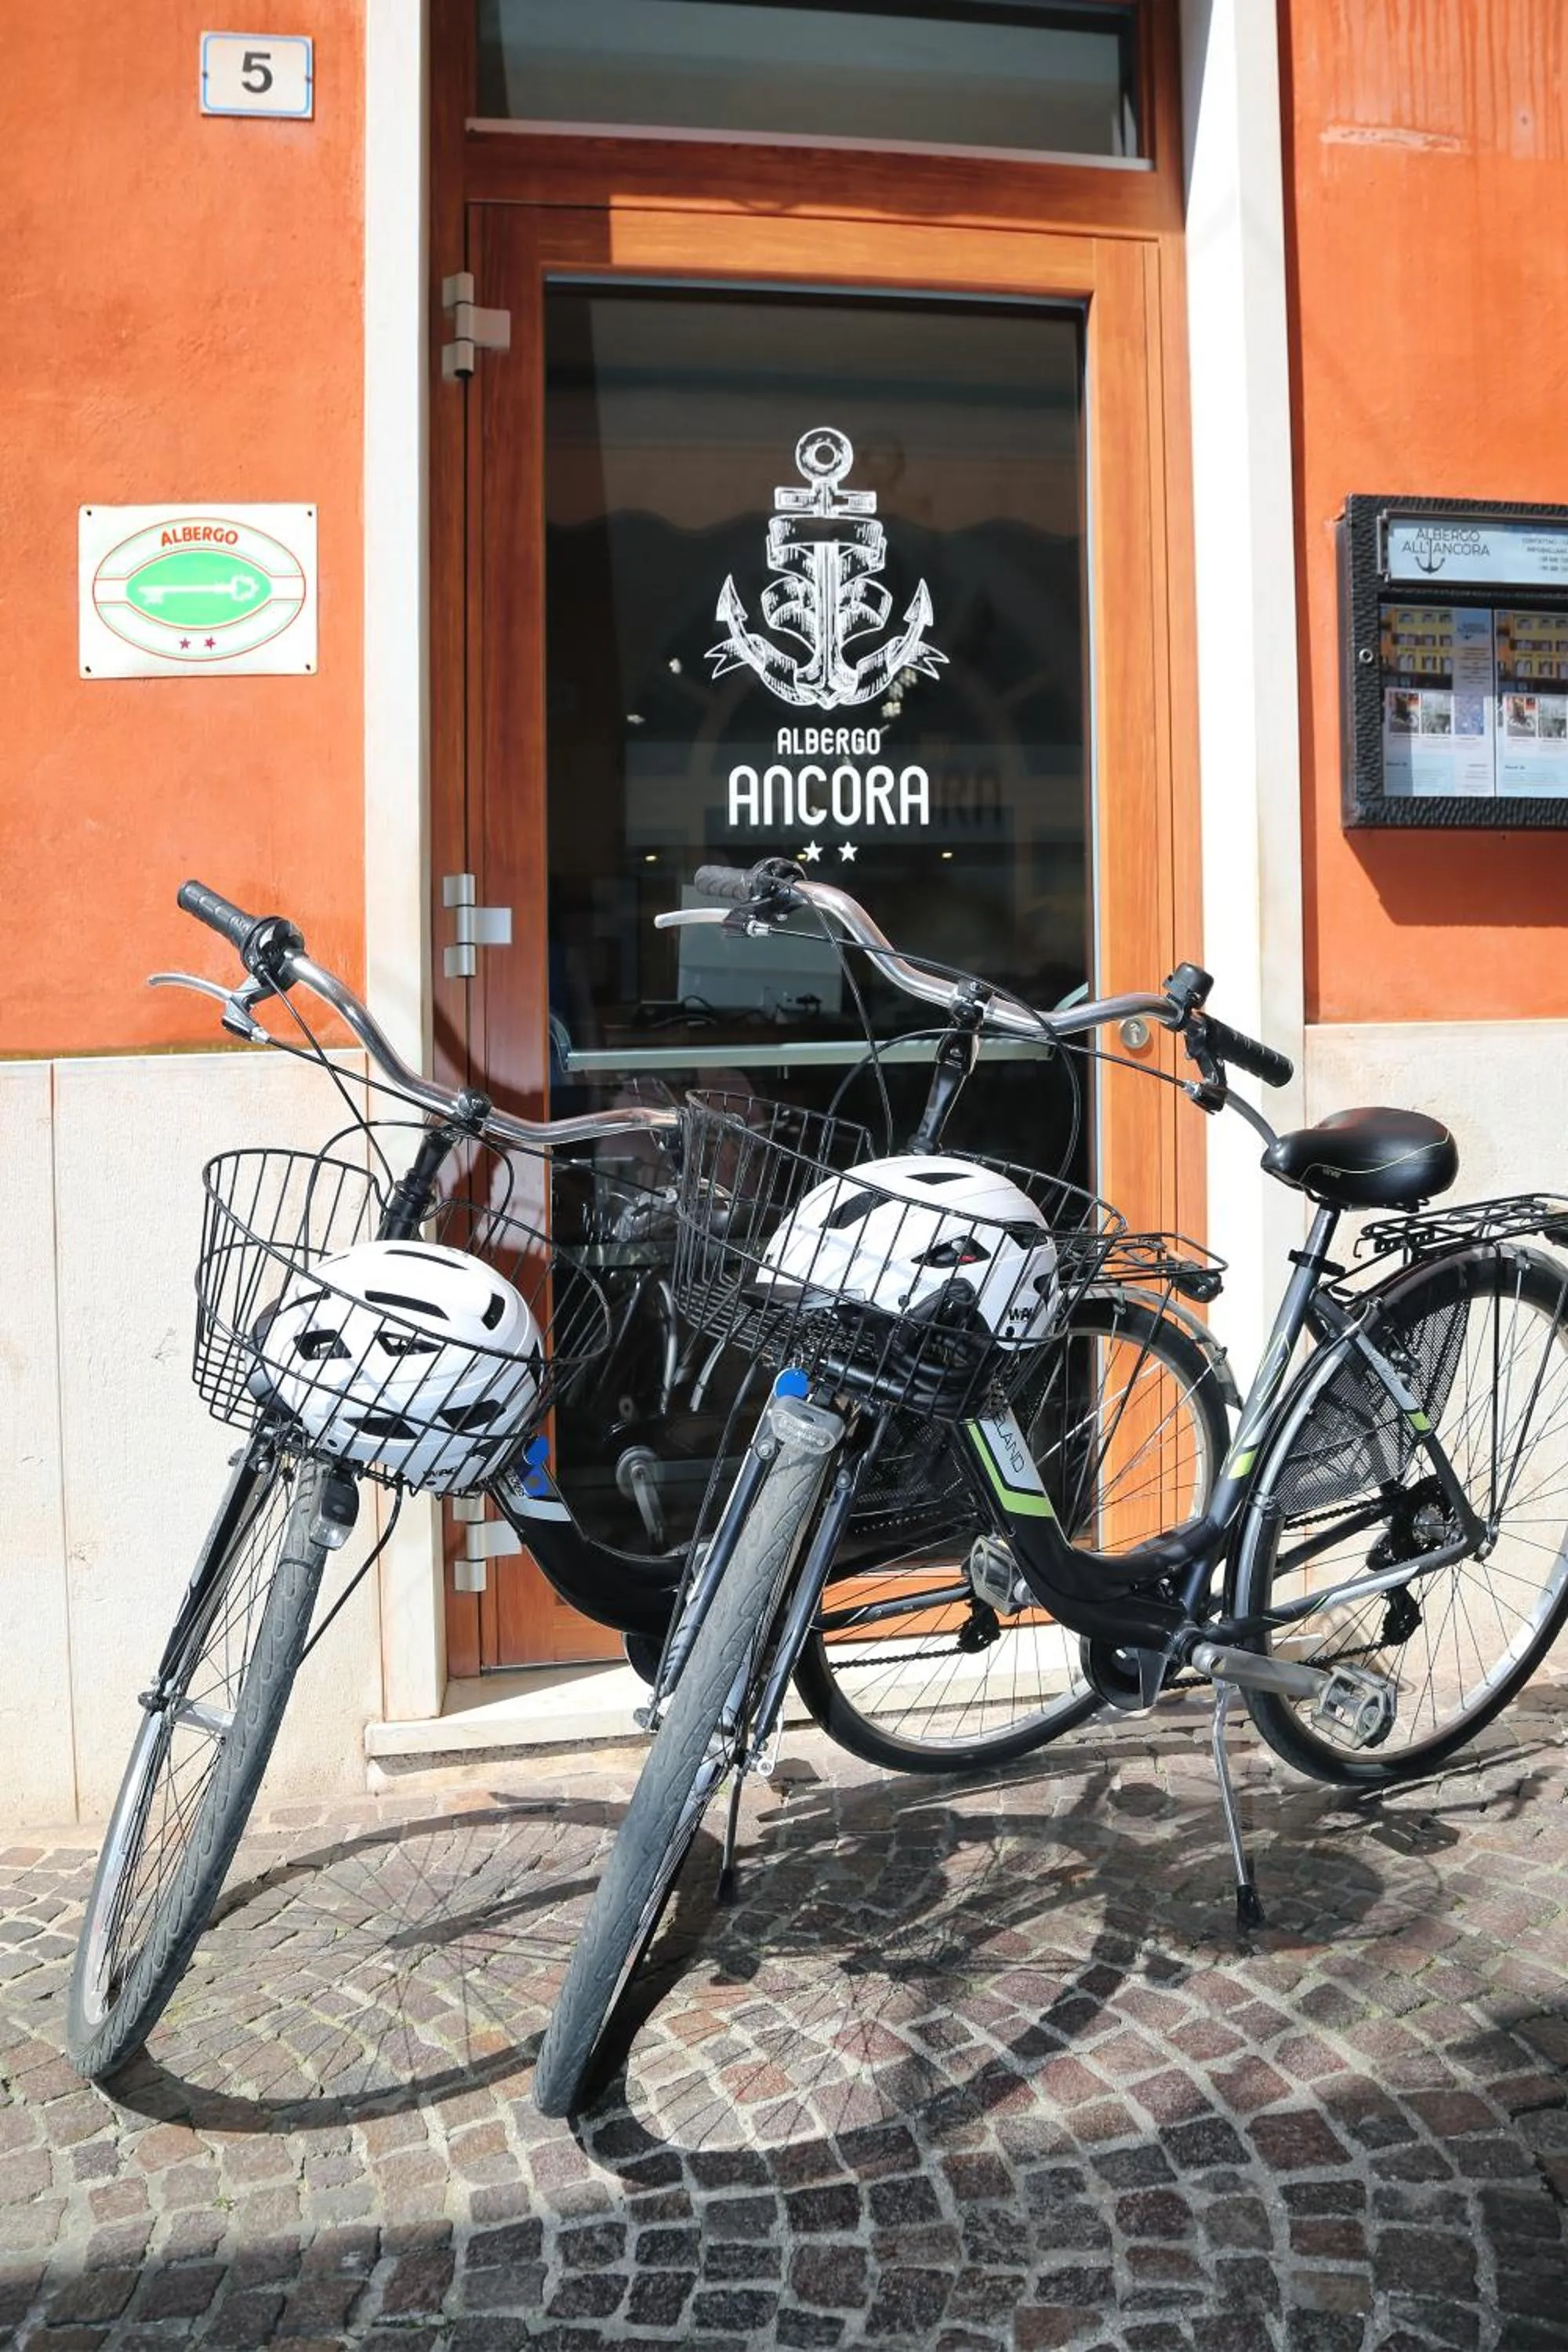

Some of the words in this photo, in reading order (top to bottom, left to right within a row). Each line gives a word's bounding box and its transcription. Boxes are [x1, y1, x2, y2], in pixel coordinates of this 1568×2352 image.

[242, 51, 273, 93] 5
[160, 526, 238, 547] ALBERGO
[1416, 528, 1480, 543] ALBERGO
[777, 728, 880, 755] ALBERGO
[728, 765, 929, 826] ANCORA
